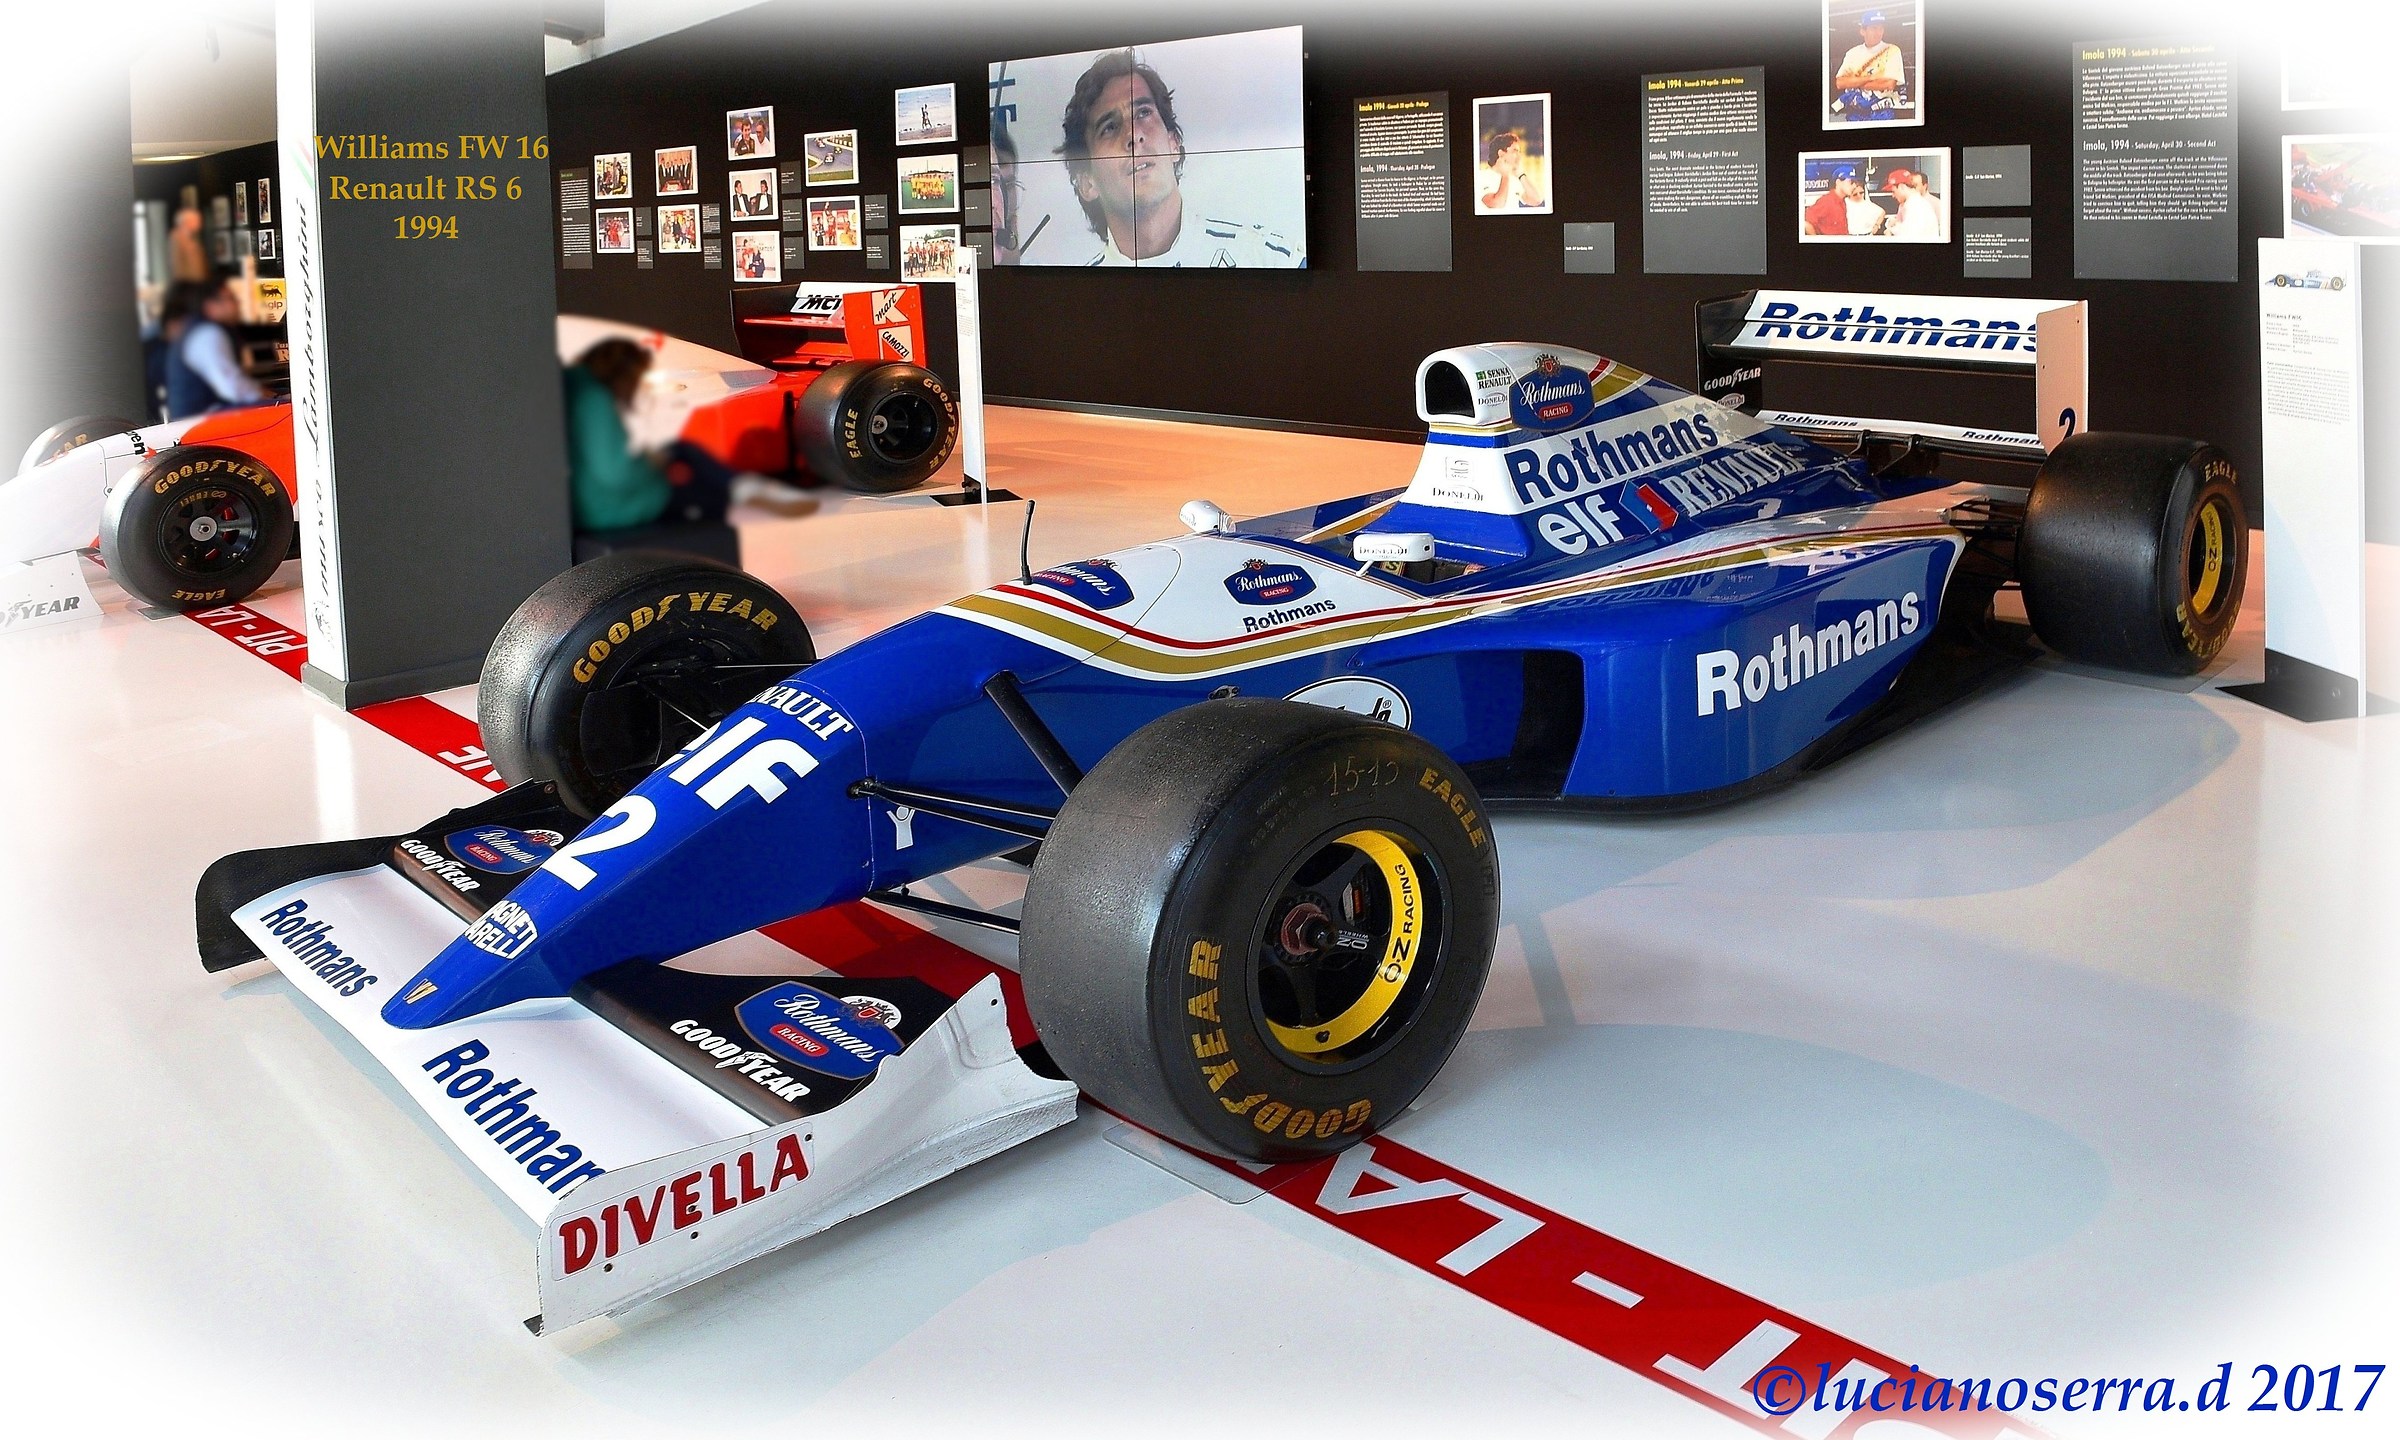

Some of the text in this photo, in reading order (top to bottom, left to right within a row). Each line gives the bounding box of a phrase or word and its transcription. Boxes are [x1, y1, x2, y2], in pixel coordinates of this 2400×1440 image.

[2082, 49, 2105, 60] Imola
[2107, 48, 2127, 58] 1994
[1648, 79, 1666, 90] Imola
[1667, 79, 1682, 89] 1994
[1669, 150, 1685, 159] 1994
[2083, 139, 2108, 152] Imola,
[2110, 139, 2130, 150] 1994
[296, 196, 320, 468] Lamborghini
[882, 331, 910, 358] CAMOZZI
[1478, 375, 1513, 390] RENAULT
[1487, 367, 1511, 379] SENNA
[1520, 380, 1587, 406] Rothmans
[1543, 405, 1570, 419] RACING
[1773, 412, 1858, 429] Rothmans
[2058, 406, 2077, 439] 2
[844, 408, 859, 459] EAGLE
[1504, 412, 1718, 508] Rothmans
[2204, 461, 2239, 485] EAGLE
[154, 459, 277, 498] GOODYEAR
[1658, 441, 1806, 518] RENAULT
[1538, 494, 1625, 556] elf
[172, 588, 227, 601] EAGLE
[1234, 572, 1302, 593] Rothmans
[1264, 586, 1290, 598] RACING
[1243, 598, 1337, 634] Rothmans
[572, 591, 778, 684] GOODYEAR
[1696, 591, 1920, 717] Rothmans
[1418, 767, 1487, 849] EAGLE
[469, 845, 499, 863] RACING
[473, 829, 543, 865] Rothmans
[543, 794, 658, 892] 2
[1394, 863, 1415, 935] RACING
[260, 898, 379, 998] Rothmans
[774, 993, 889, 1063] Rothmans
[777, 1026, 821, 1055] RACING
[1186, 939, 1373, 1140] GOODYEAR
[558, 1133, 811, 1276] DIVELLA
